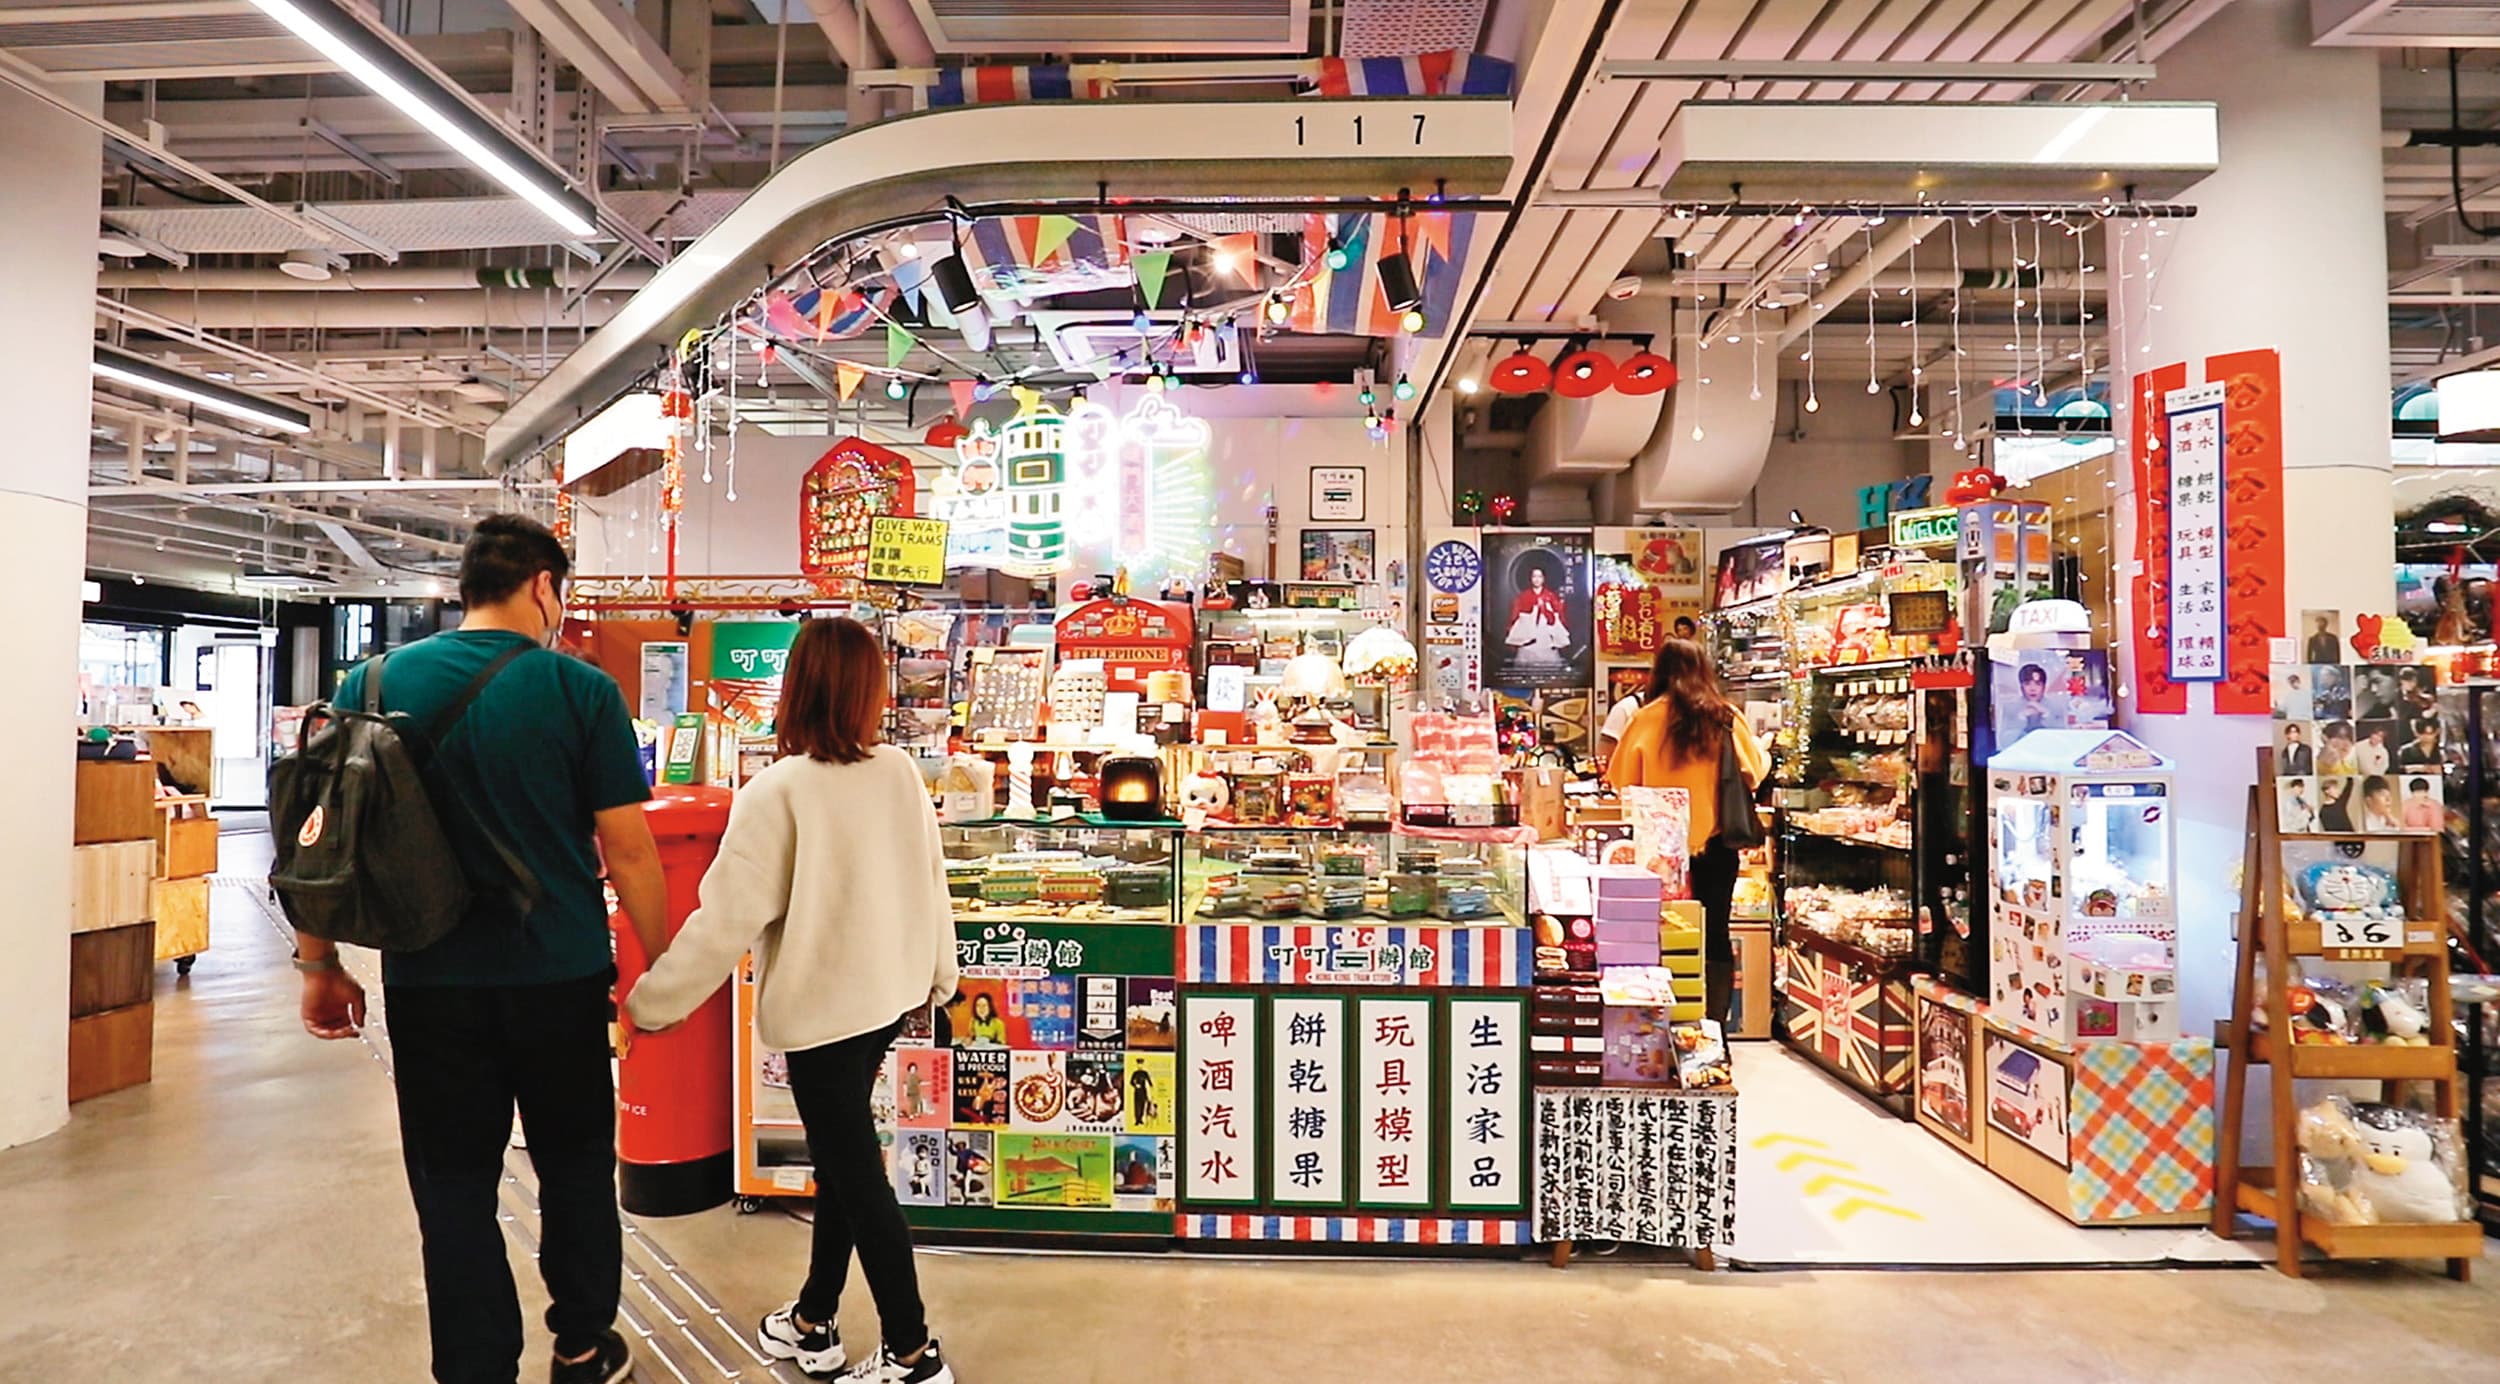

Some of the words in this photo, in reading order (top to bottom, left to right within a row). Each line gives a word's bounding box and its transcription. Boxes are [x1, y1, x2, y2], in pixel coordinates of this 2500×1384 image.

[875, 519, 906, 531] GIVE
[913, 522, 943, 533] WAY
[874, 530, 893, 543] TO
[899, 532, 943, 546] TRAMS
[2020, 606, 2059, 626] TAXI
[730, 649, 790, 673] 叮叮
[1074, 647, 1168, 661] TELEPHONE
[1270, 946, 1328, 967] 叮叮
[956, 1051, 1007, 1064] WATER
[1200, 1011, 1239, 1185] 啤酒汽水
[1288, 1012, 1328, 1188] 餅乾糖果
[1375, 1015, 1415, 1188] 玩具模型
[1466, 1015, 1505, 1188] 生活家品
